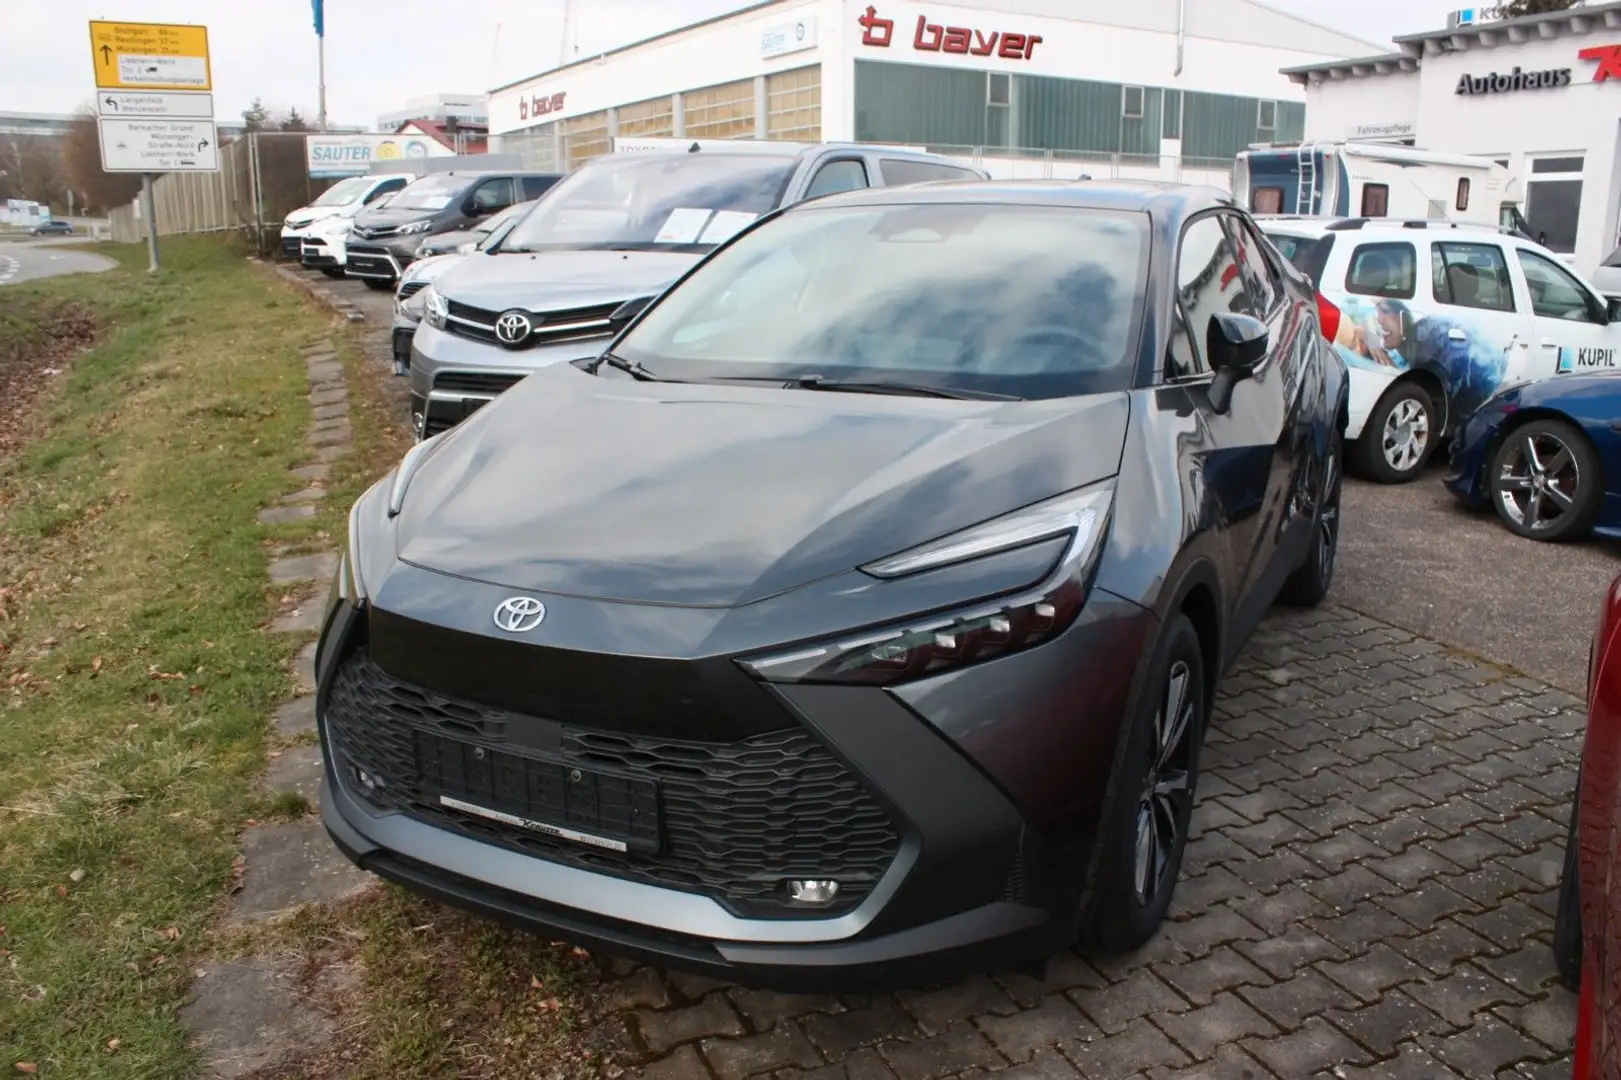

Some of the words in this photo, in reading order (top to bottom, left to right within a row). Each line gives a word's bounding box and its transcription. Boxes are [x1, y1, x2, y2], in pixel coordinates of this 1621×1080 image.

[913, 14, 1043, 61] bayer
[1454, 65, 1572, 96] Autohaus
[531, 91, 567, 118] bayer
[1357, 123, 1412, 136] Fahrzeugpflege
[312, 146, 371, 161] SAUTER
[1578, 347, 1616, 367] KUPIL
